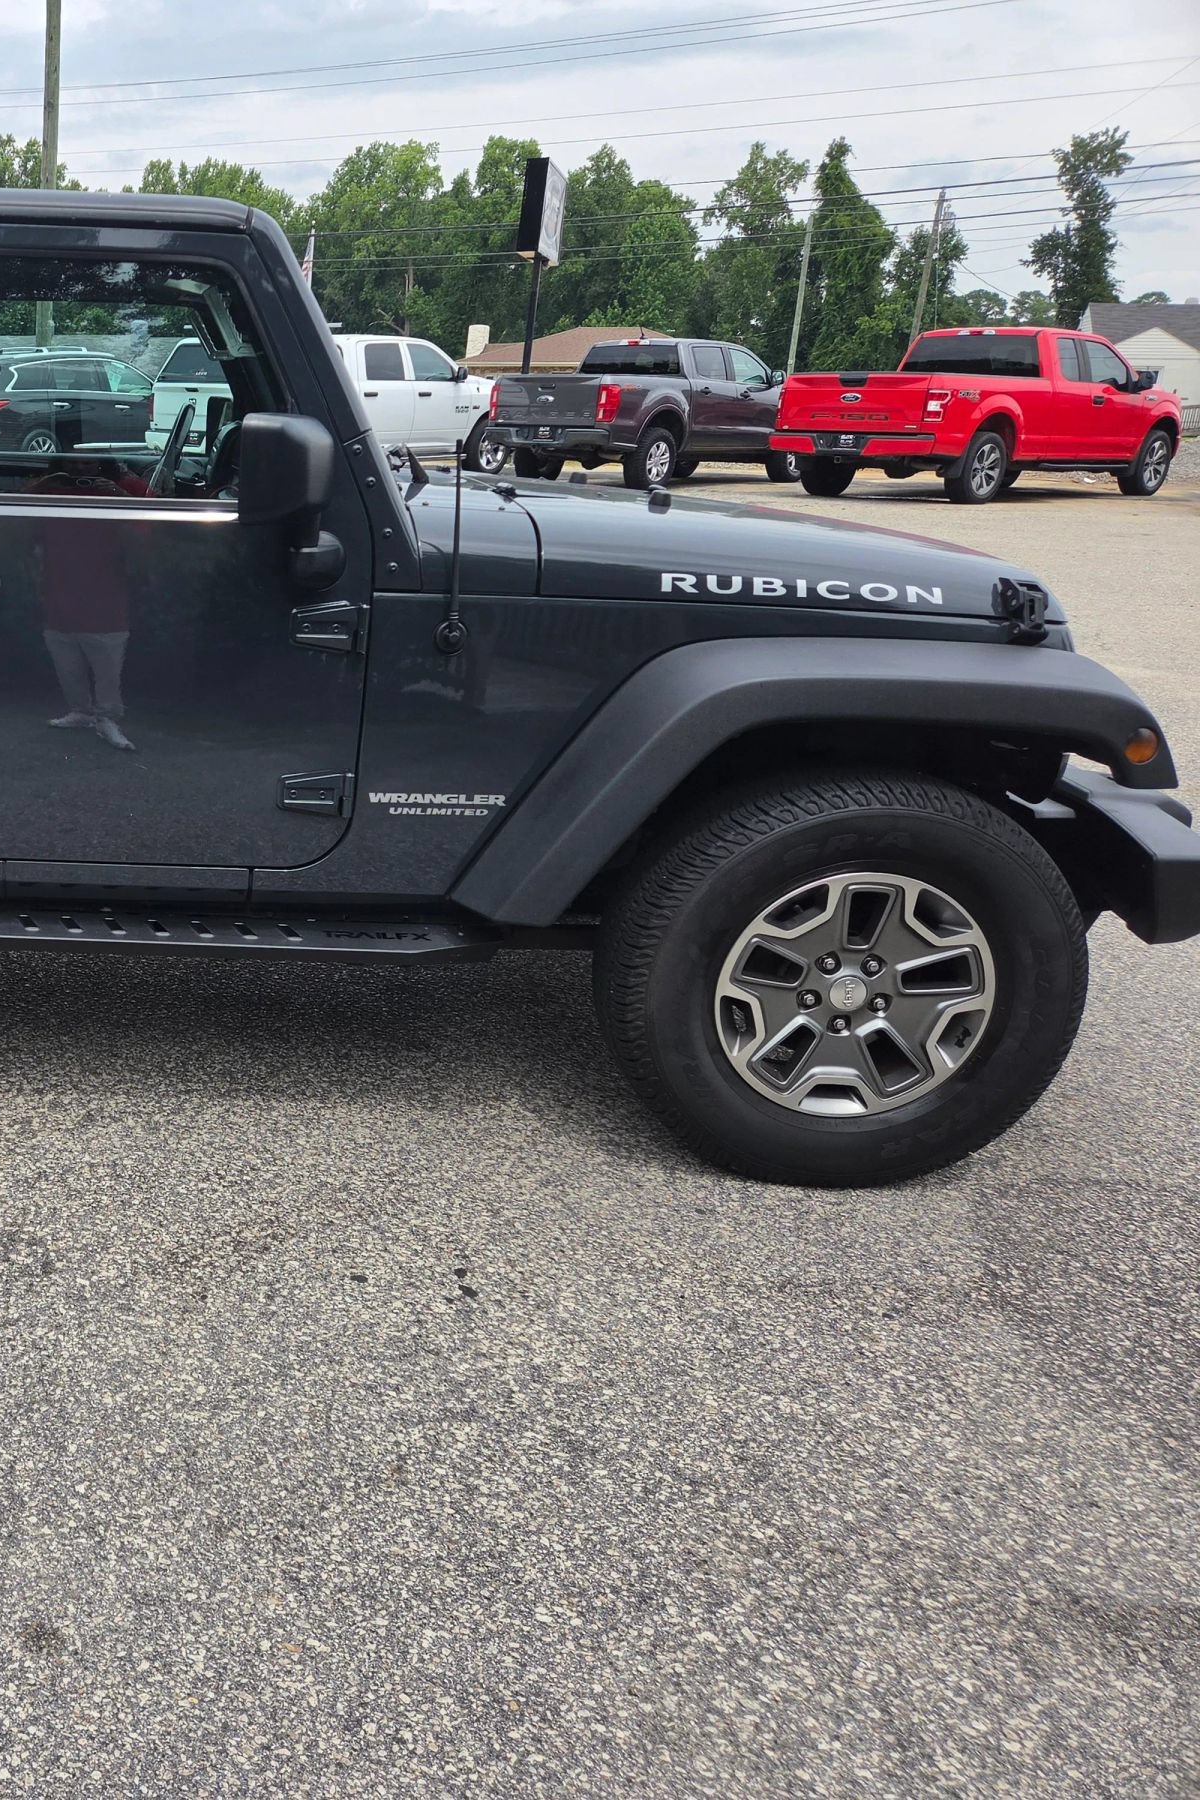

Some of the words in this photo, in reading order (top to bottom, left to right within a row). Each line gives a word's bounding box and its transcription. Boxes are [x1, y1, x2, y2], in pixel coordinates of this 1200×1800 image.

[810, 412, 890, 421] F-150
[660, 572, 945, 605] RUBICON
[368, 792, 506, 806] WRANGLER
[388, 807, 489, 816] UNLIMITED
[322, 930, 432, 941] TRAILFX
[842, 980, 856, 1007] Jeep
